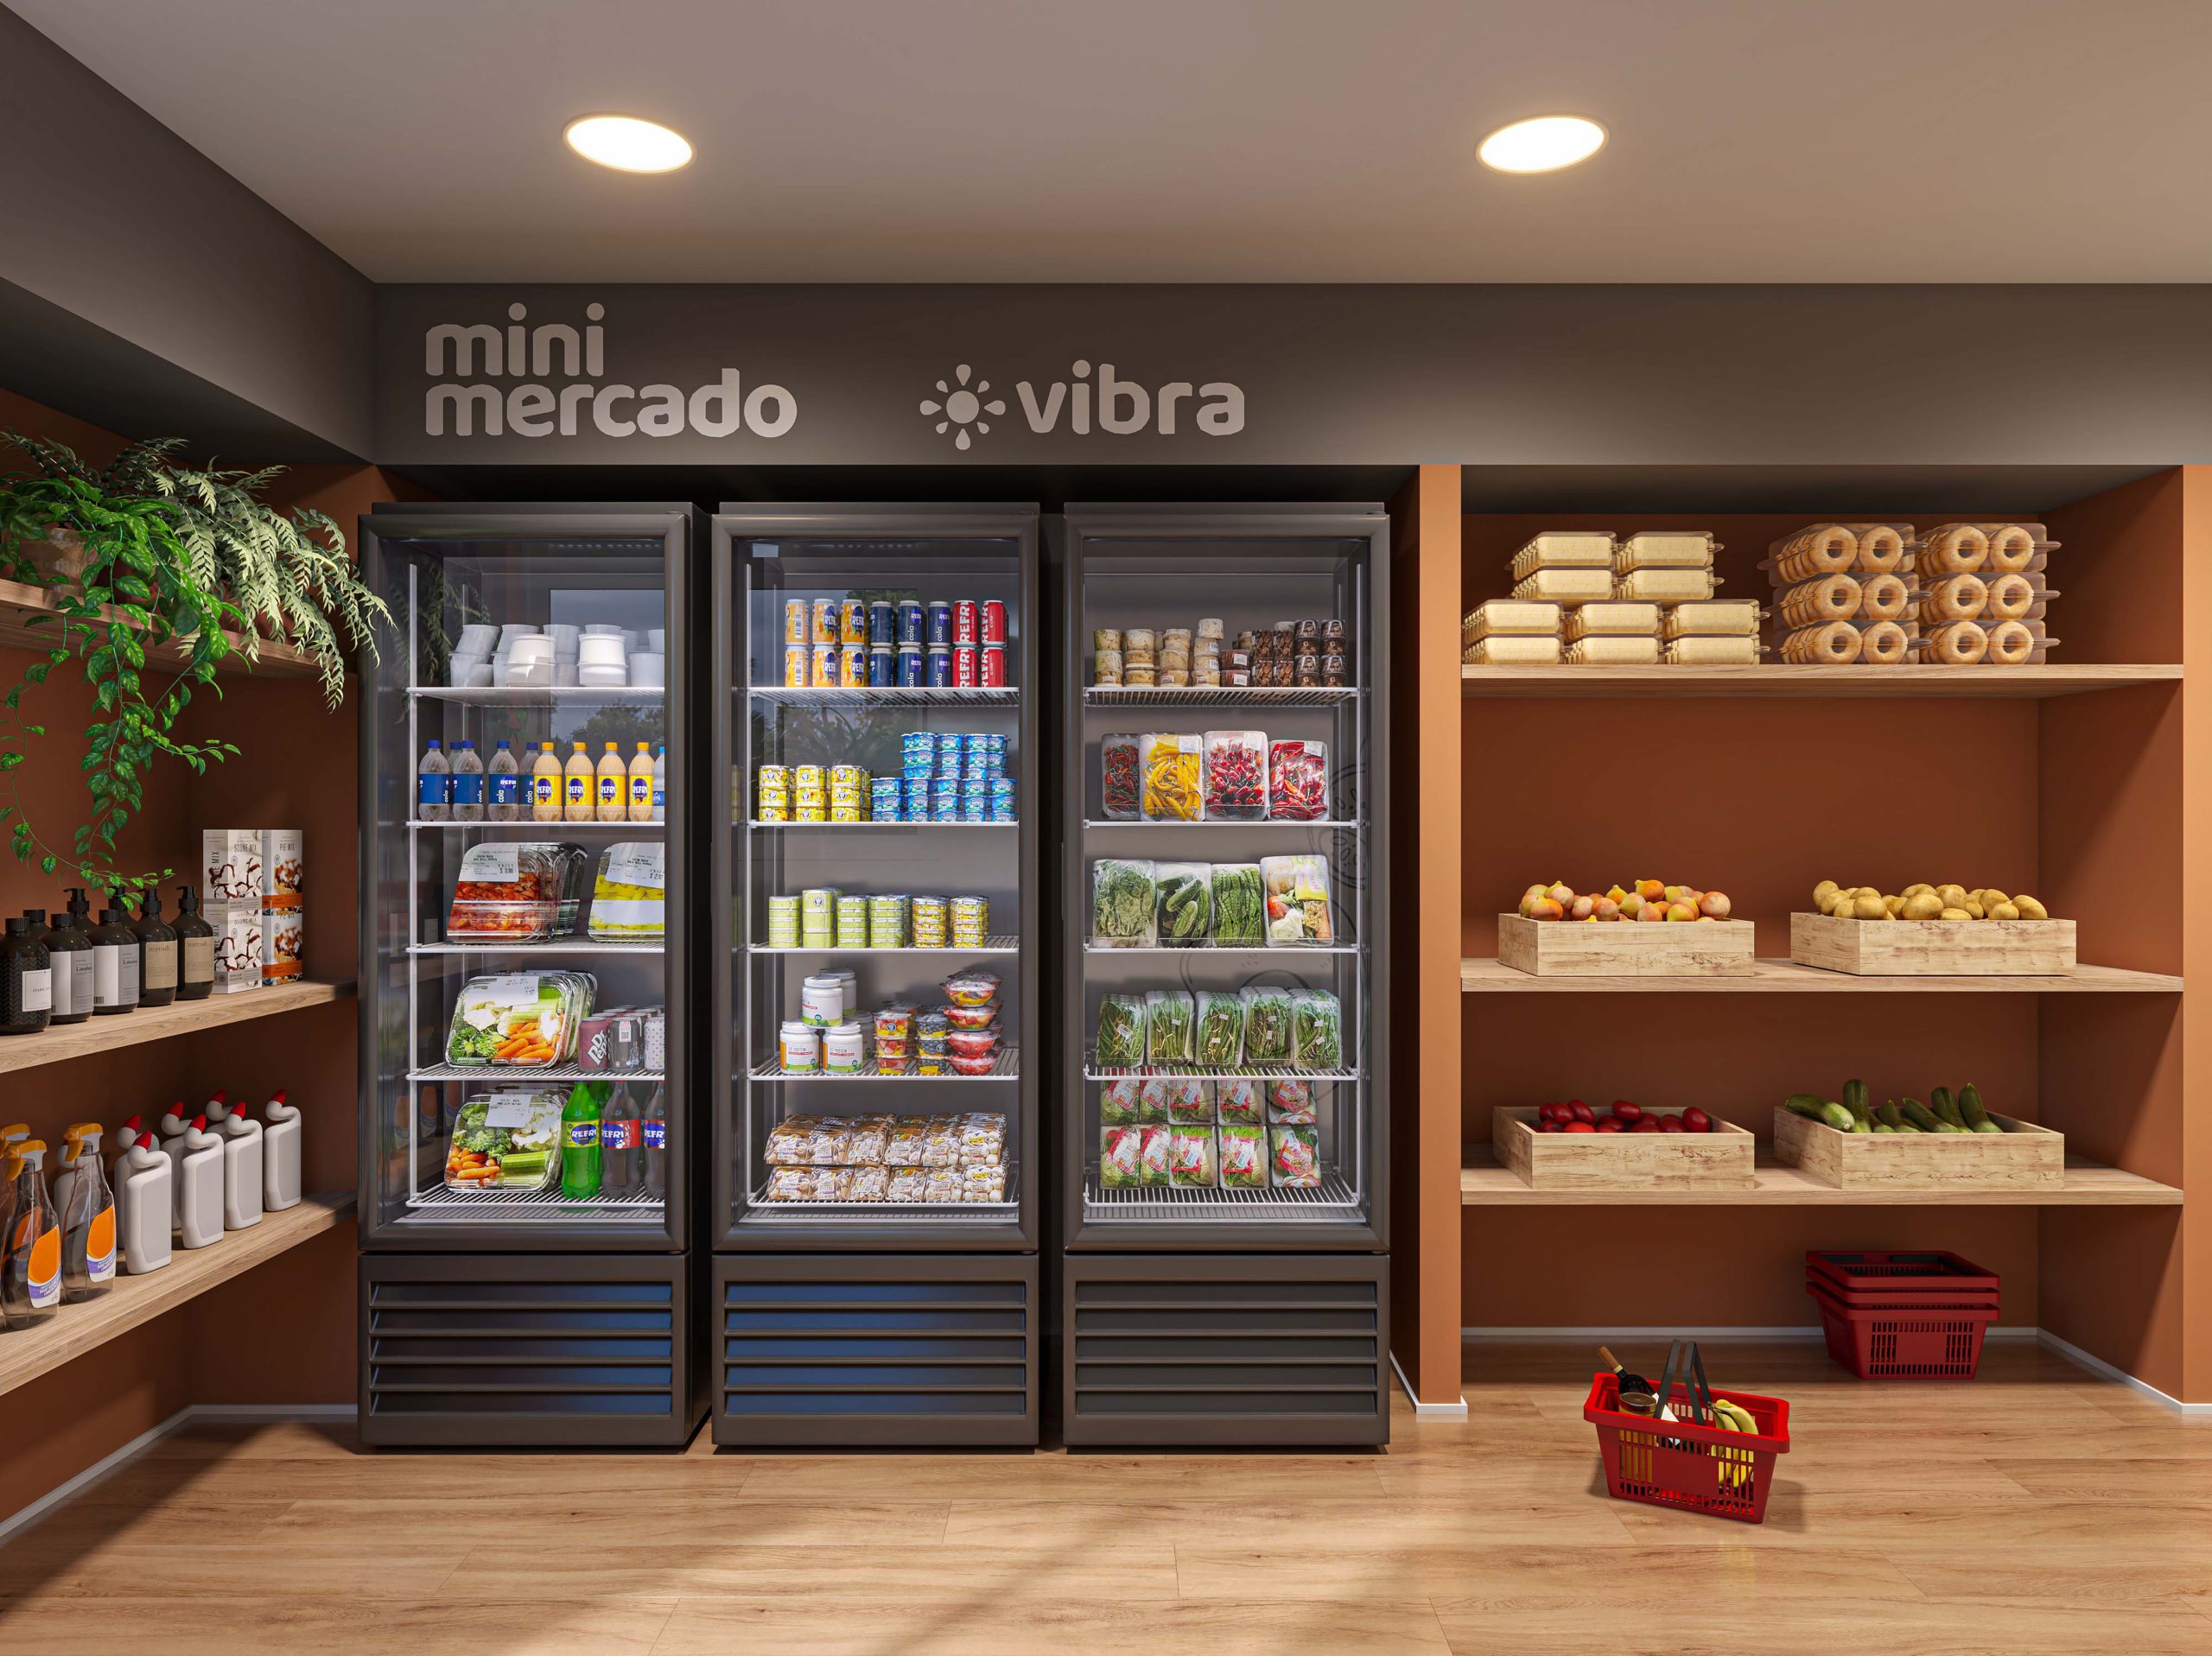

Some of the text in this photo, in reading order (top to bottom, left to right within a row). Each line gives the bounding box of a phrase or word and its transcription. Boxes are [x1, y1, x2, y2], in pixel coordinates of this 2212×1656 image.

[426, 302, 604, 377] mini
[426, 368, 798, 438] mercado
[1016, 360, 1245, 436] vibra
[496, 790, 505, 803] cola
[571, 1128, 597, 1139] REFRI
